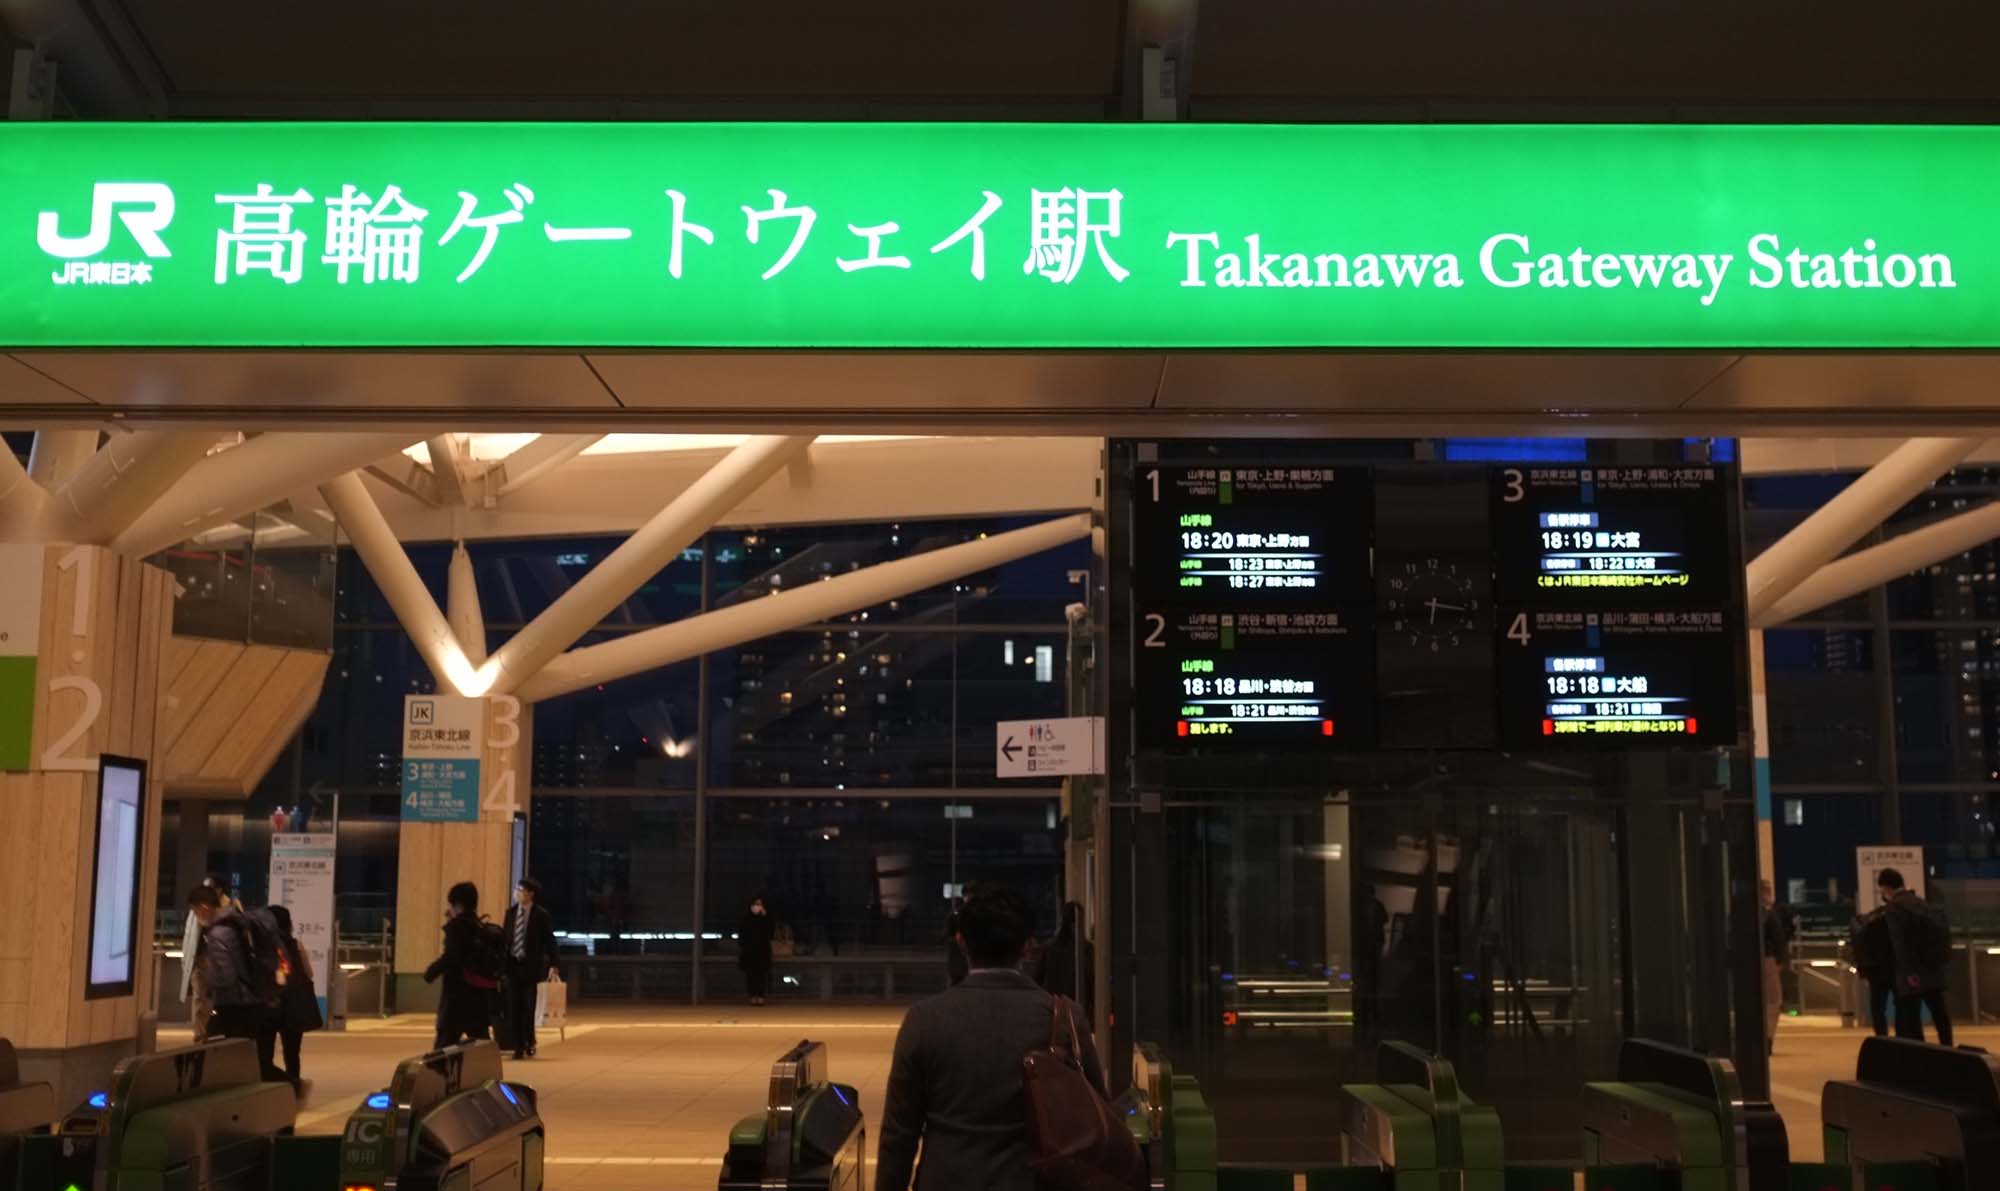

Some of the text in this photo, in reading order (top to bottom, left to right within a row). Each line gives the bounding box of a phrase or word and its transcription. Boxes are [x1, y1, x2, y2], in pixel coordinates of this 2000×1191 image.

[37, 183, 175, 258] JR
[214, 183, 1956, 306] 高輪ゲートウェイ駅 Takanawa Gateway Station
[51, 262, 153, 285] JR東日本
[1147, 469, 1160, 503] 1
[1503, 468, 1526, 503] 3
[1181, 531, 1234, 550] 18:20
[1541, 531, 1594, 550] 18:19
[1610, 531, 1641, 549] 大宮
[1228, 557, 1264, 571] 18:23
[1588, 557, 1624, 570] 18:22
[57, 544, 93, 637] 1
[1228, 575, 1264, 588] 18:27
[1143, 612, 1167, 648] 2
[1506, 612, 1533, 647] 4
[1183, 677, 1236, 696] 18:18
[1547, 676, 1600, 694] 18:18
[413, 707, 430, 719] JK
[1230, 704, 1266, 717] 18:21
[1594, 703, 1630, 715] 18:21
[41, 675, 102, 771] 2
[487, 695, 521, 749] 3
[409, 728, 471, 743] 京浜東北線
[407, 762, 419, 781] 3
[405, 791, 419, 809] 4
[482, 769, 522, 823] 4
[346, 1119, 383, 1144] IC
